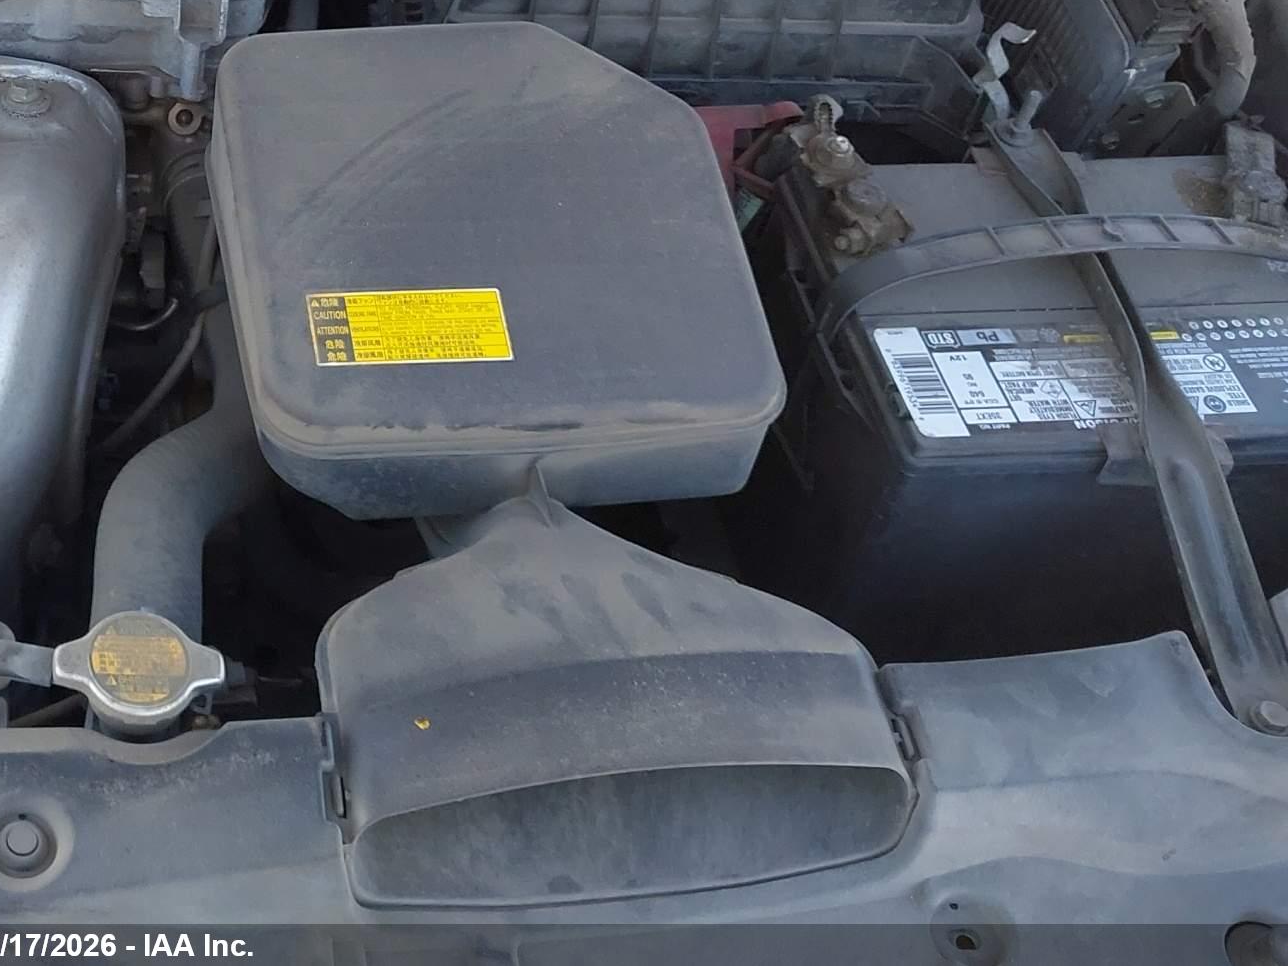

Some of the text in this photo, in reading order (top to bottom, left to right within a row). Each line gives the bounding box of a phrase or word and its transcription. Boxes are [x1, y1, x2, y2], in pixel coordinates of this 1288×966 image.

[314, 310, 347, 320] CAUTION
[317, 325, 349, 335] ATTENTION
[928, 333, 954, 344] STD
[976, 331, 1000, 342] Pb
